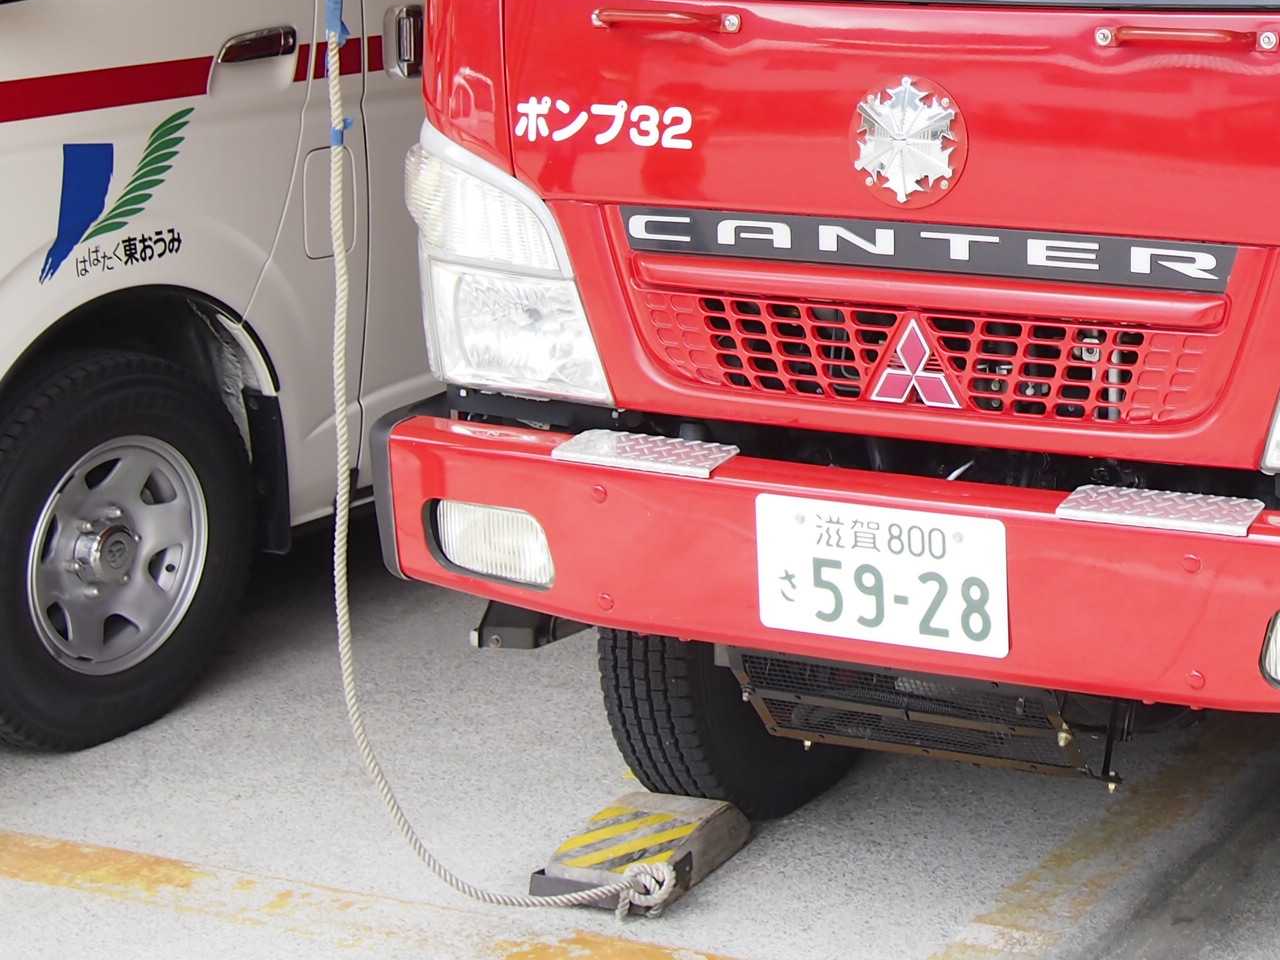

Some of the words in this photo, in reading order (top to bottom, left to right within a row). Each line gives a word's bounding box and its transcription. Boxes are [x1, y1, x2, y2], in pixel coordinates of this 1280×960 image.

[514, 95, 693, 151] ポンプ32
[75, 227, 182, 278] はばたく東おうみ
[628, 214, 1220, 280] CANTER
[812, 556, 992, 643] 59-28
